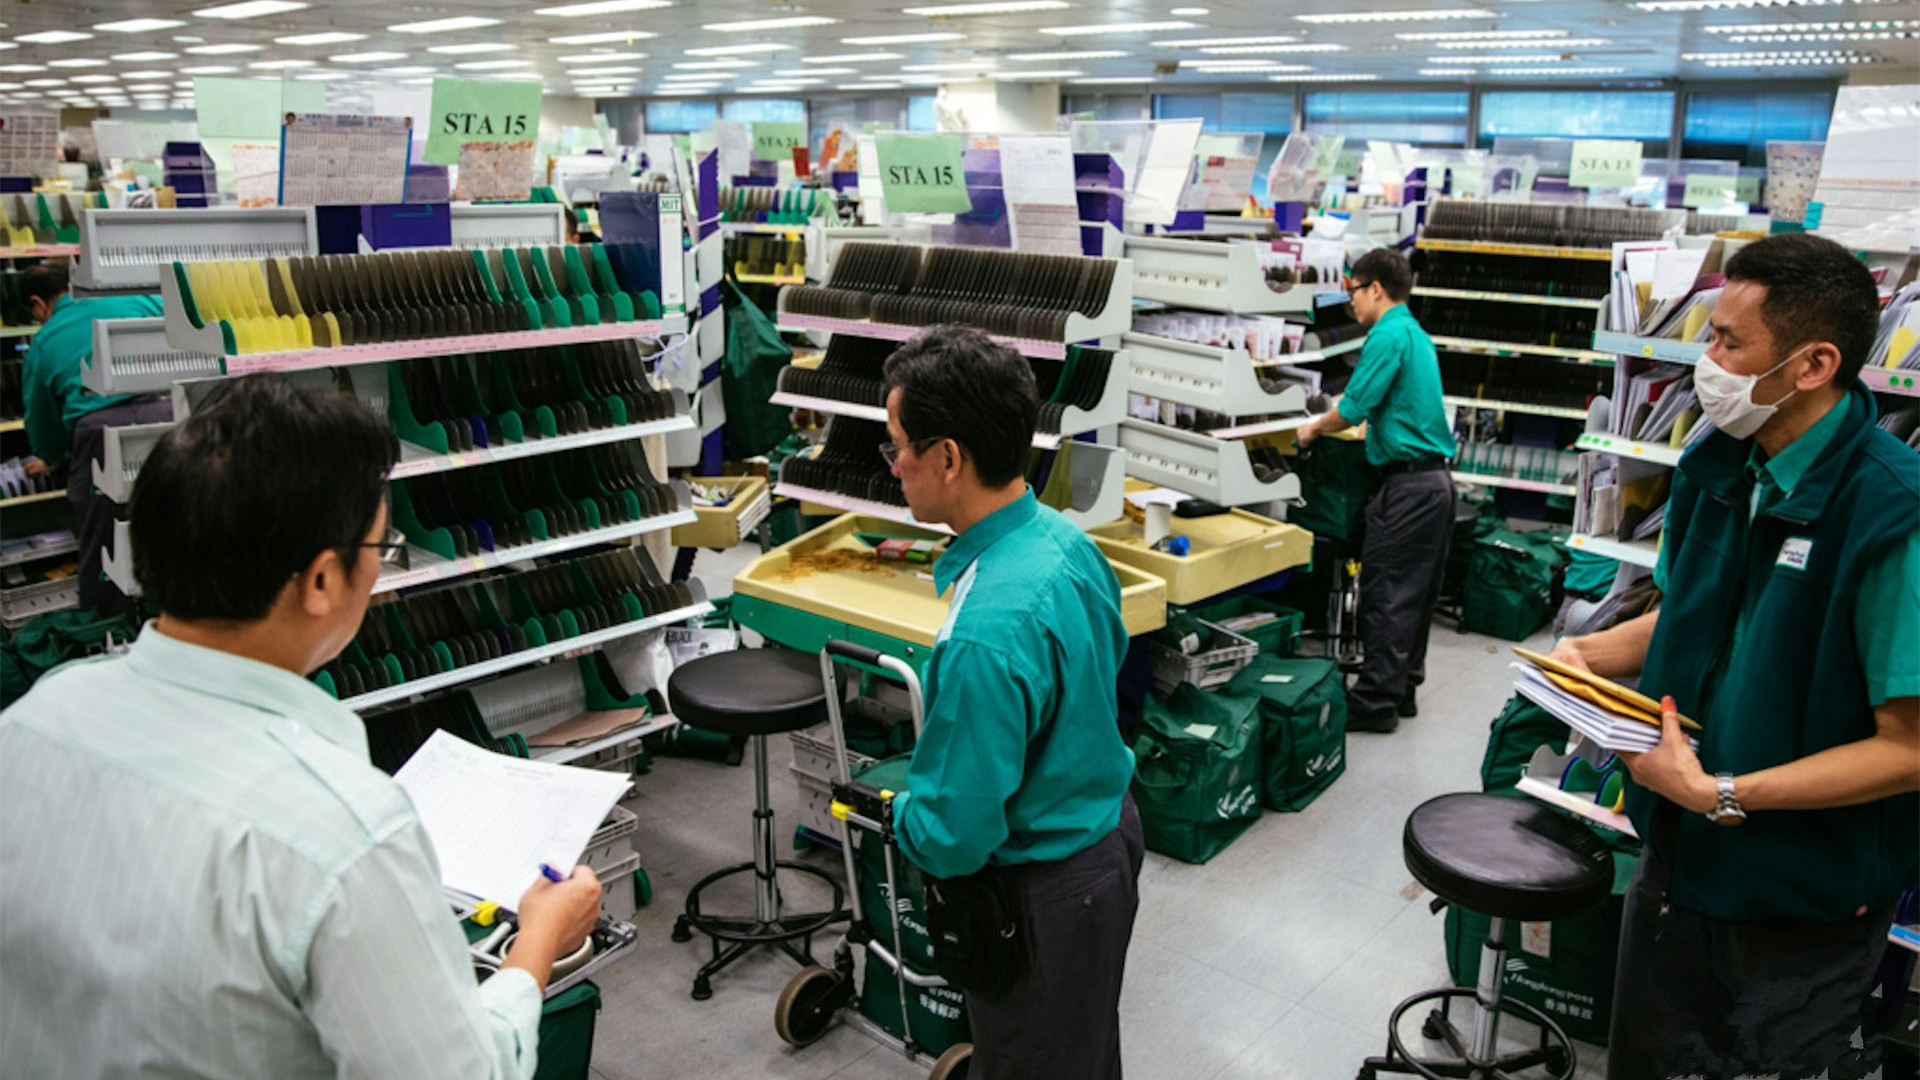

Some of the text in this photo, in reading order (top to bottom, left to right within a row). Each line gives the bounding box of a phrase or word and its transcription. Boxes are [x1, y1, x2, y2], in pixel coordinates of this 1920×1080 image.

[443, 112, 527, 135] STA 15
[757, 136, 783, 148] STA
[1579, 158, 1609, 170] STA
[889, 165, 954, 185] STA 15
